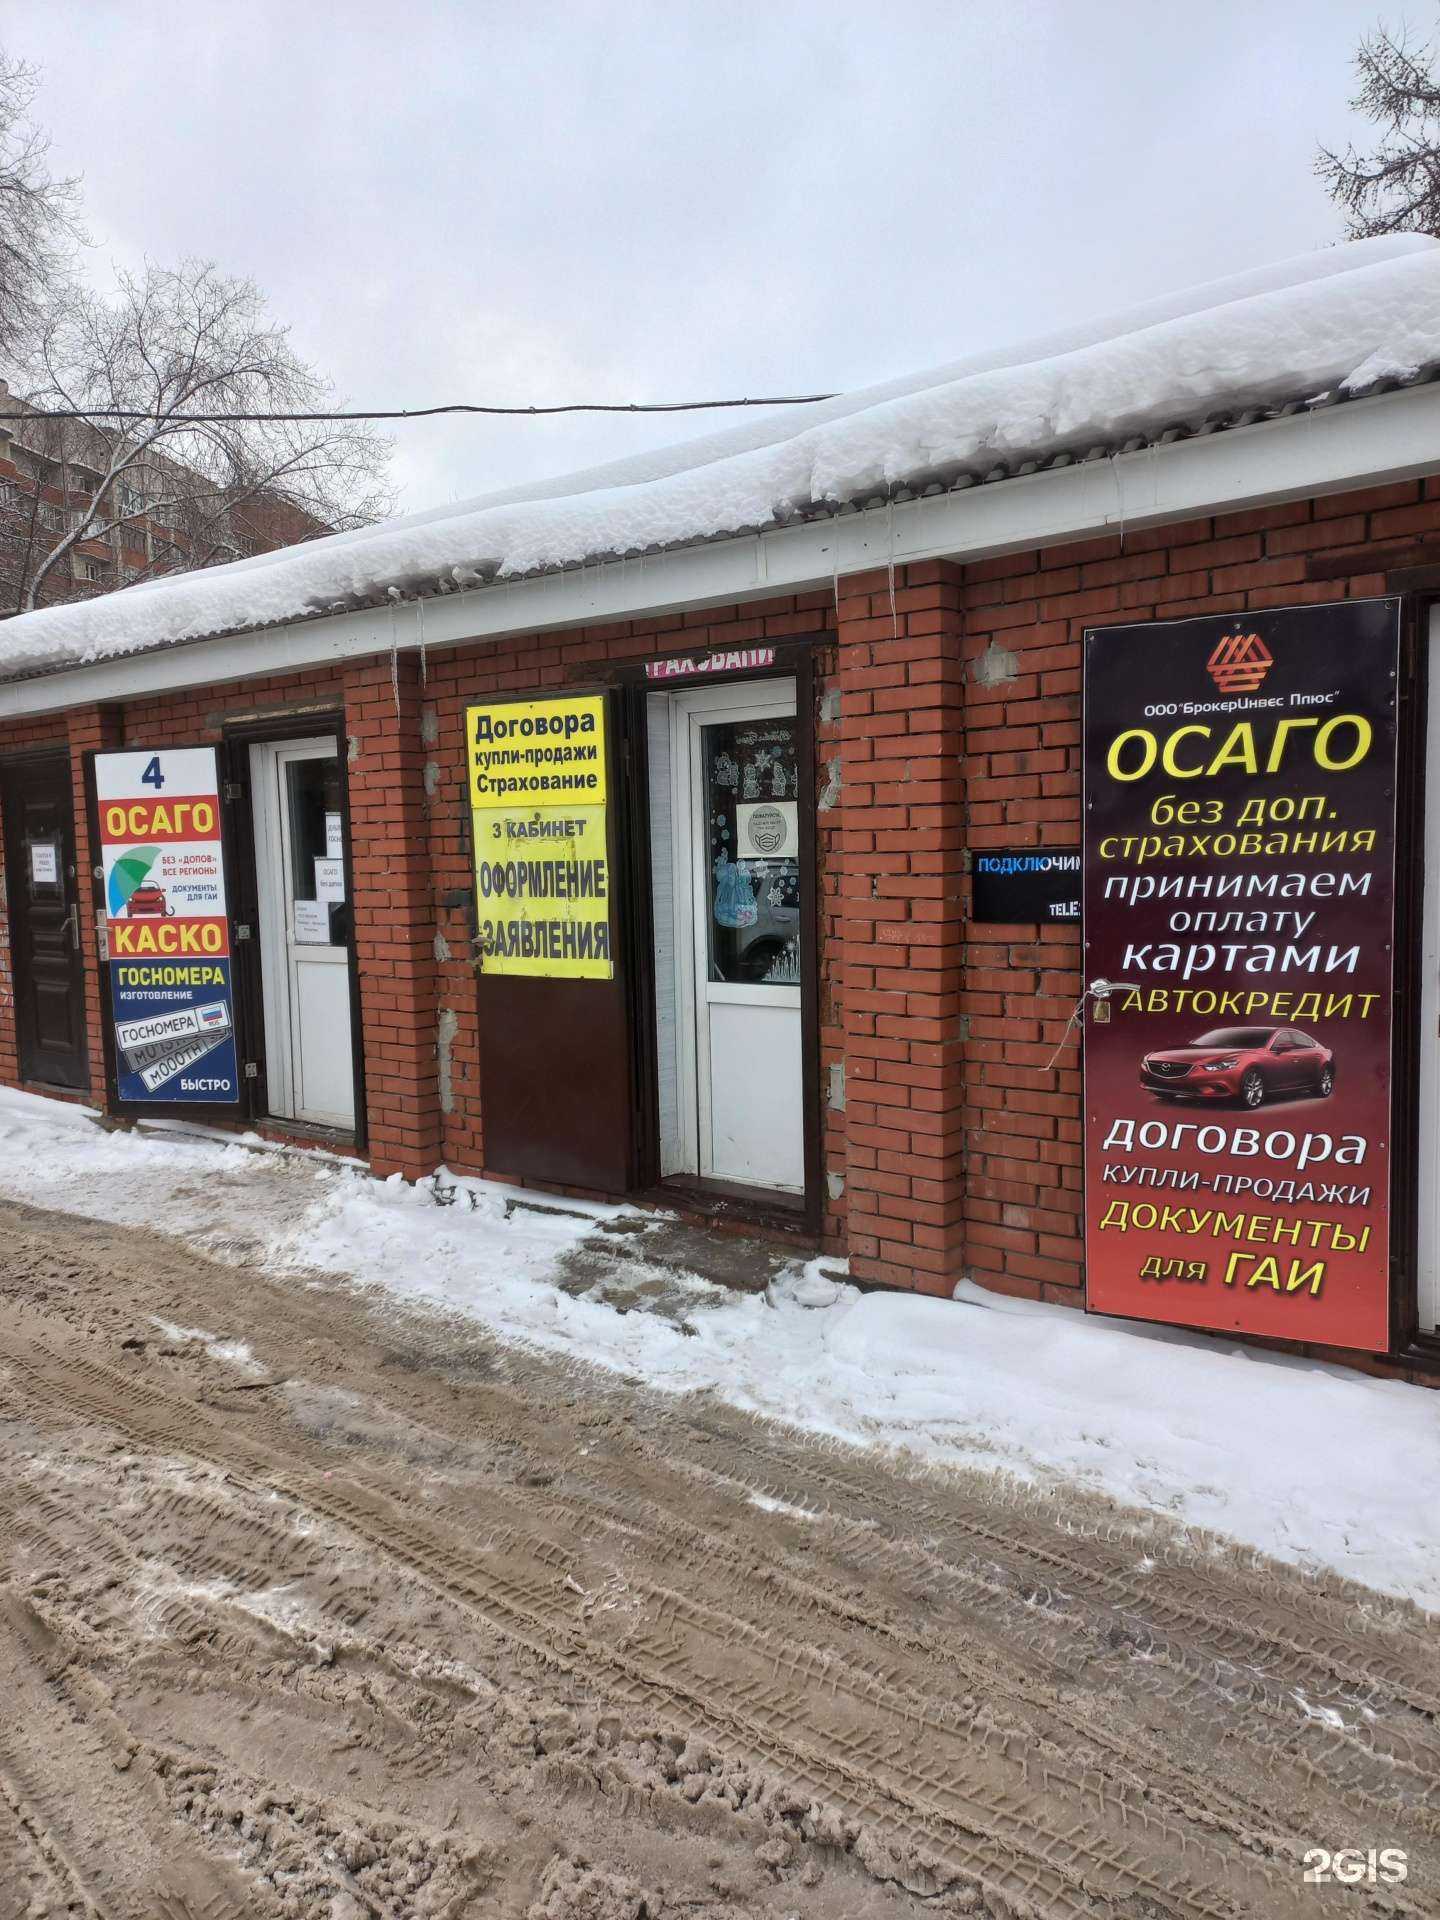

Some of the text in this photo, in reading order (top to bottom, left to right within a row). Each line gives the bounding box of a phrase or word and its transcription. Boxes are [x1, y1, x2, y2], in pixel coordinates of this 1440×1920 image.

[475, 712, 595, 745] Договора
[475, 744, 597, 770] купли-продажи
[1105, 713, 1374, 783] ОСАГО
[142, 756, 165, 789] 4
[477, 771, 598, 796] Страхование
[106, 802, 214, 837] ОСАГО
[1150, 794, 1338, 828] без доп.
[507, 819, 587, 838] КАБИНЕТ
[162, 856, 176, 864] БЕЗ
[1099, 828, 1377, 865] страхования
[162, 867, 217, 876] ВСЕ РЕГИОНЫ
[480, 859, 606, 898] ОФОРМЛЕНИЕ
[1104, 870, 1372, 906] принимаем
[172, 885, 217, 893] ДОКУМЕНТЫ
[187, 893, 203, 901] ДЛЯ
[1049, 901, 1080, 916] TELE
[1169, 909, 1317, 939] оплату
[114, 923, 222, 953] КАСКО
[482, 919, 608, 960] ЗАЯВЛЕНИЯ
[118, 967, 225, 986] ГОСНОМЕРА
[1121, 942, 1360, 980] картами
[120, 991, 193, 1000] ИЗГОТОВЛЕНИЕ
[1121, 989, 1380, 1023] АВТОКРЕДИТ
[122, 1016, 195, 1043] ГОСНОМЕРА
[180, 1079, 231, 1091] БЫСТРО
[1102, 1118, 1367, 1170] договора
[1102, 1163, 1371, 1207] КУПЛИ-ПРОДАЖИ
[1099, 1200, 1373, 1254] ДОКУМЕНТЫ
[1139, 1252, 1325, 1295] для ГАИ
